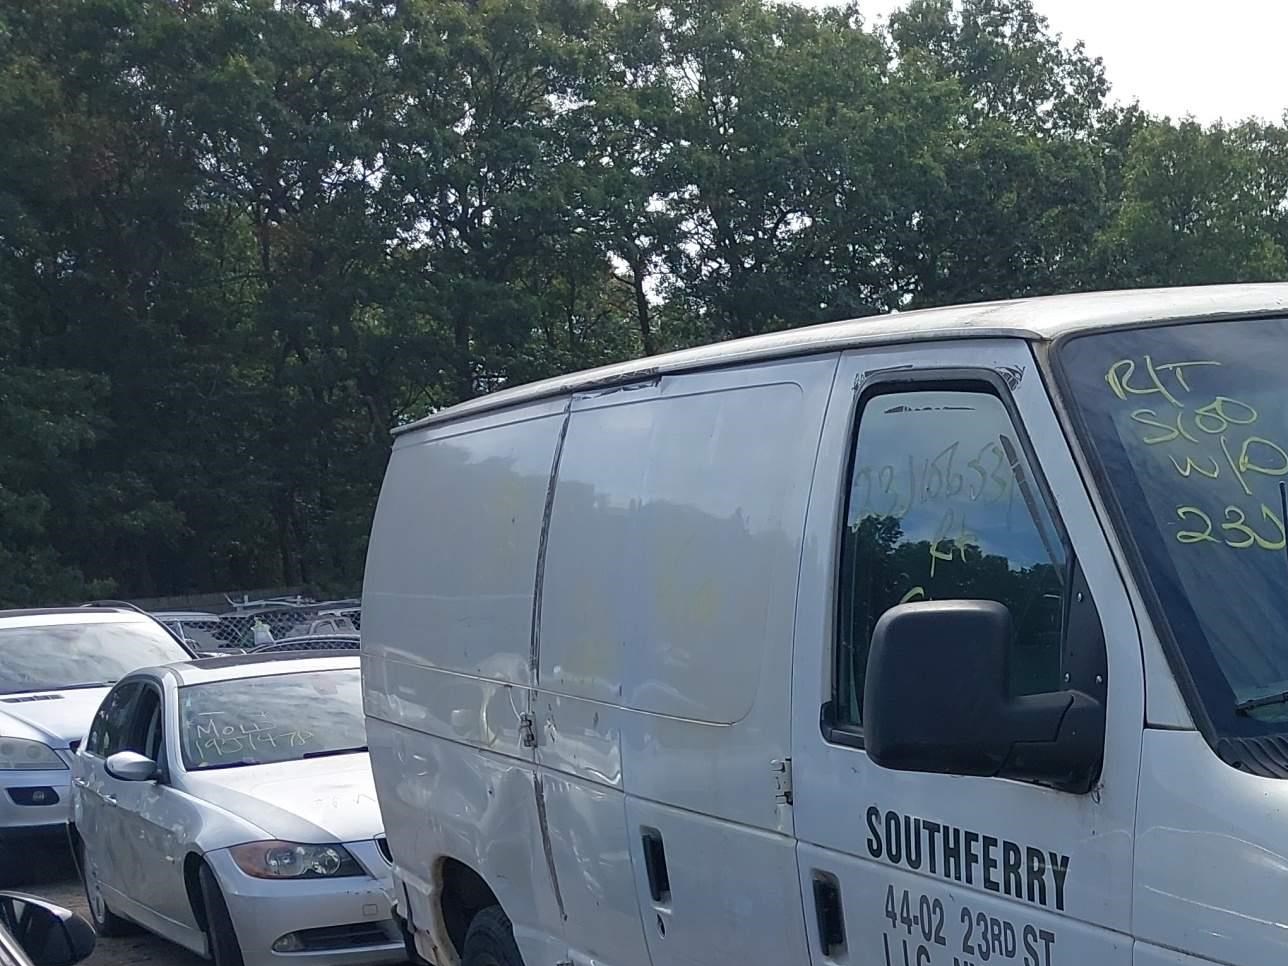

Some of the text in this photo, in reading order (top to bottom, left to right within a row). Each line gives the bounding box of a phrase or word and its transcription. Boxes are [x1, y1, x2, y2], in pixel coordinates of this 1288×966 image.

[866, 806, 1070, 911] SOUTHFERRY
[885, 884, 946, 946] 44-02
[960, 907, 1017, 962] 23RD
